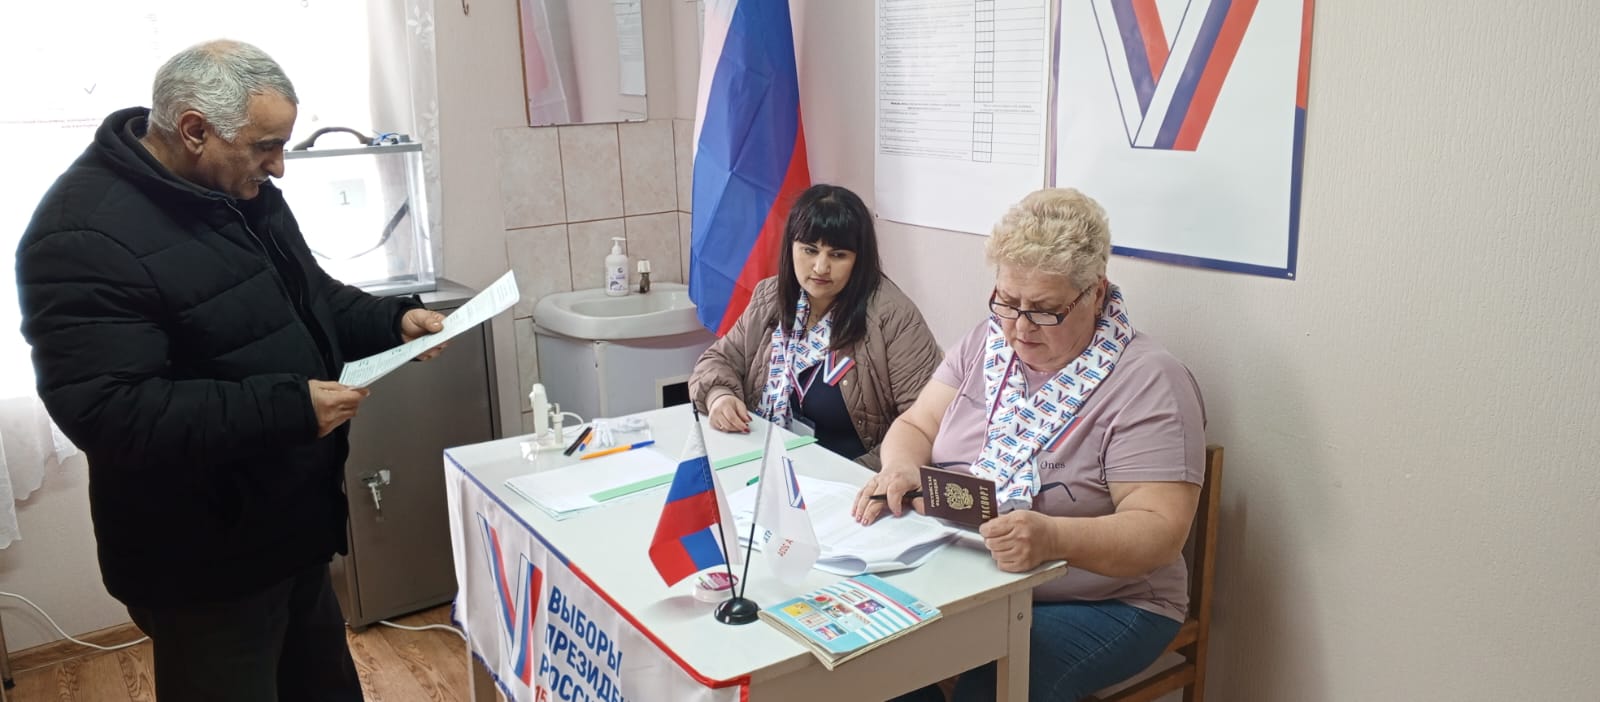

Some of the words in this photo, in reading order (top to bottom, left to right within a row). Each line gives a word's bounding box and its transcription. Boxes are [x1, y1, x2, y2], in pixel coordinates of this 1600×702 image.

[339, 190, 351, 206] 1
[979, 486, 991, 519] ПАСПОРТ
[548, 585, 622, 678] ВЫБОРЫ
[545, 623, 625, 702] ПРЕЗИДЕ
